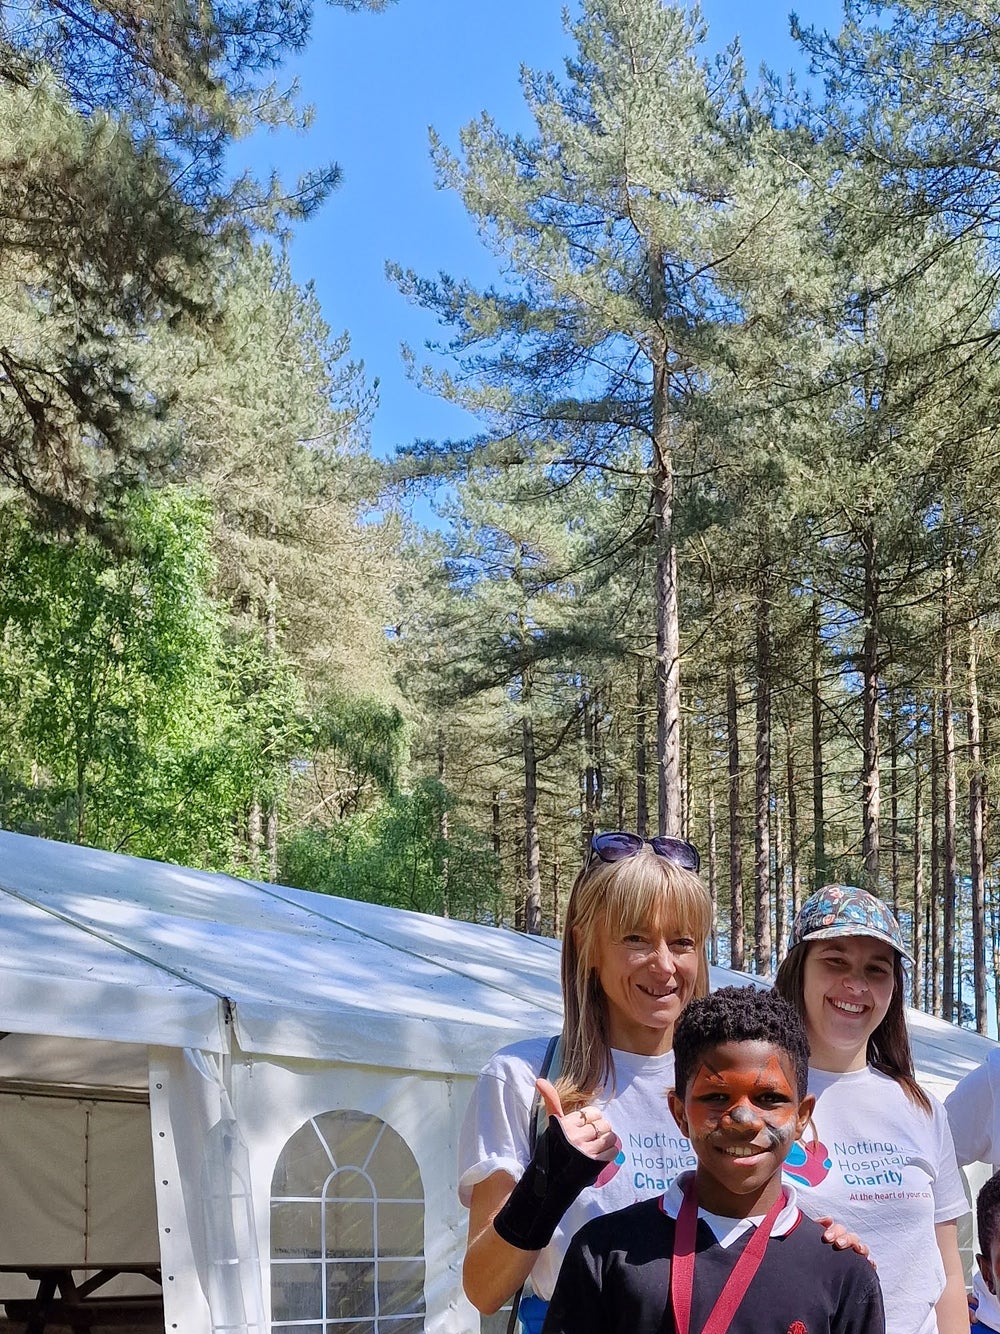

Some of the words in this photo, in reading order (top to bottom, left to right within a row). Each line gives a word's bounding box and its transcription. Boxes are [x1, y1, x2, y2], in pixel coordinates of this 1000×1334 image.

[833, 1140, 903, 1156] Notting
[632, 1152, 697, 1174] Hospita
[634, 1172, 673, 1190] Char
[844, 1170, 903, 1186] Charity
[860, 1193, 873, 1201] the
[875, 1191, 896, 1200] heart
[898, 1191, 905, 1199] of
